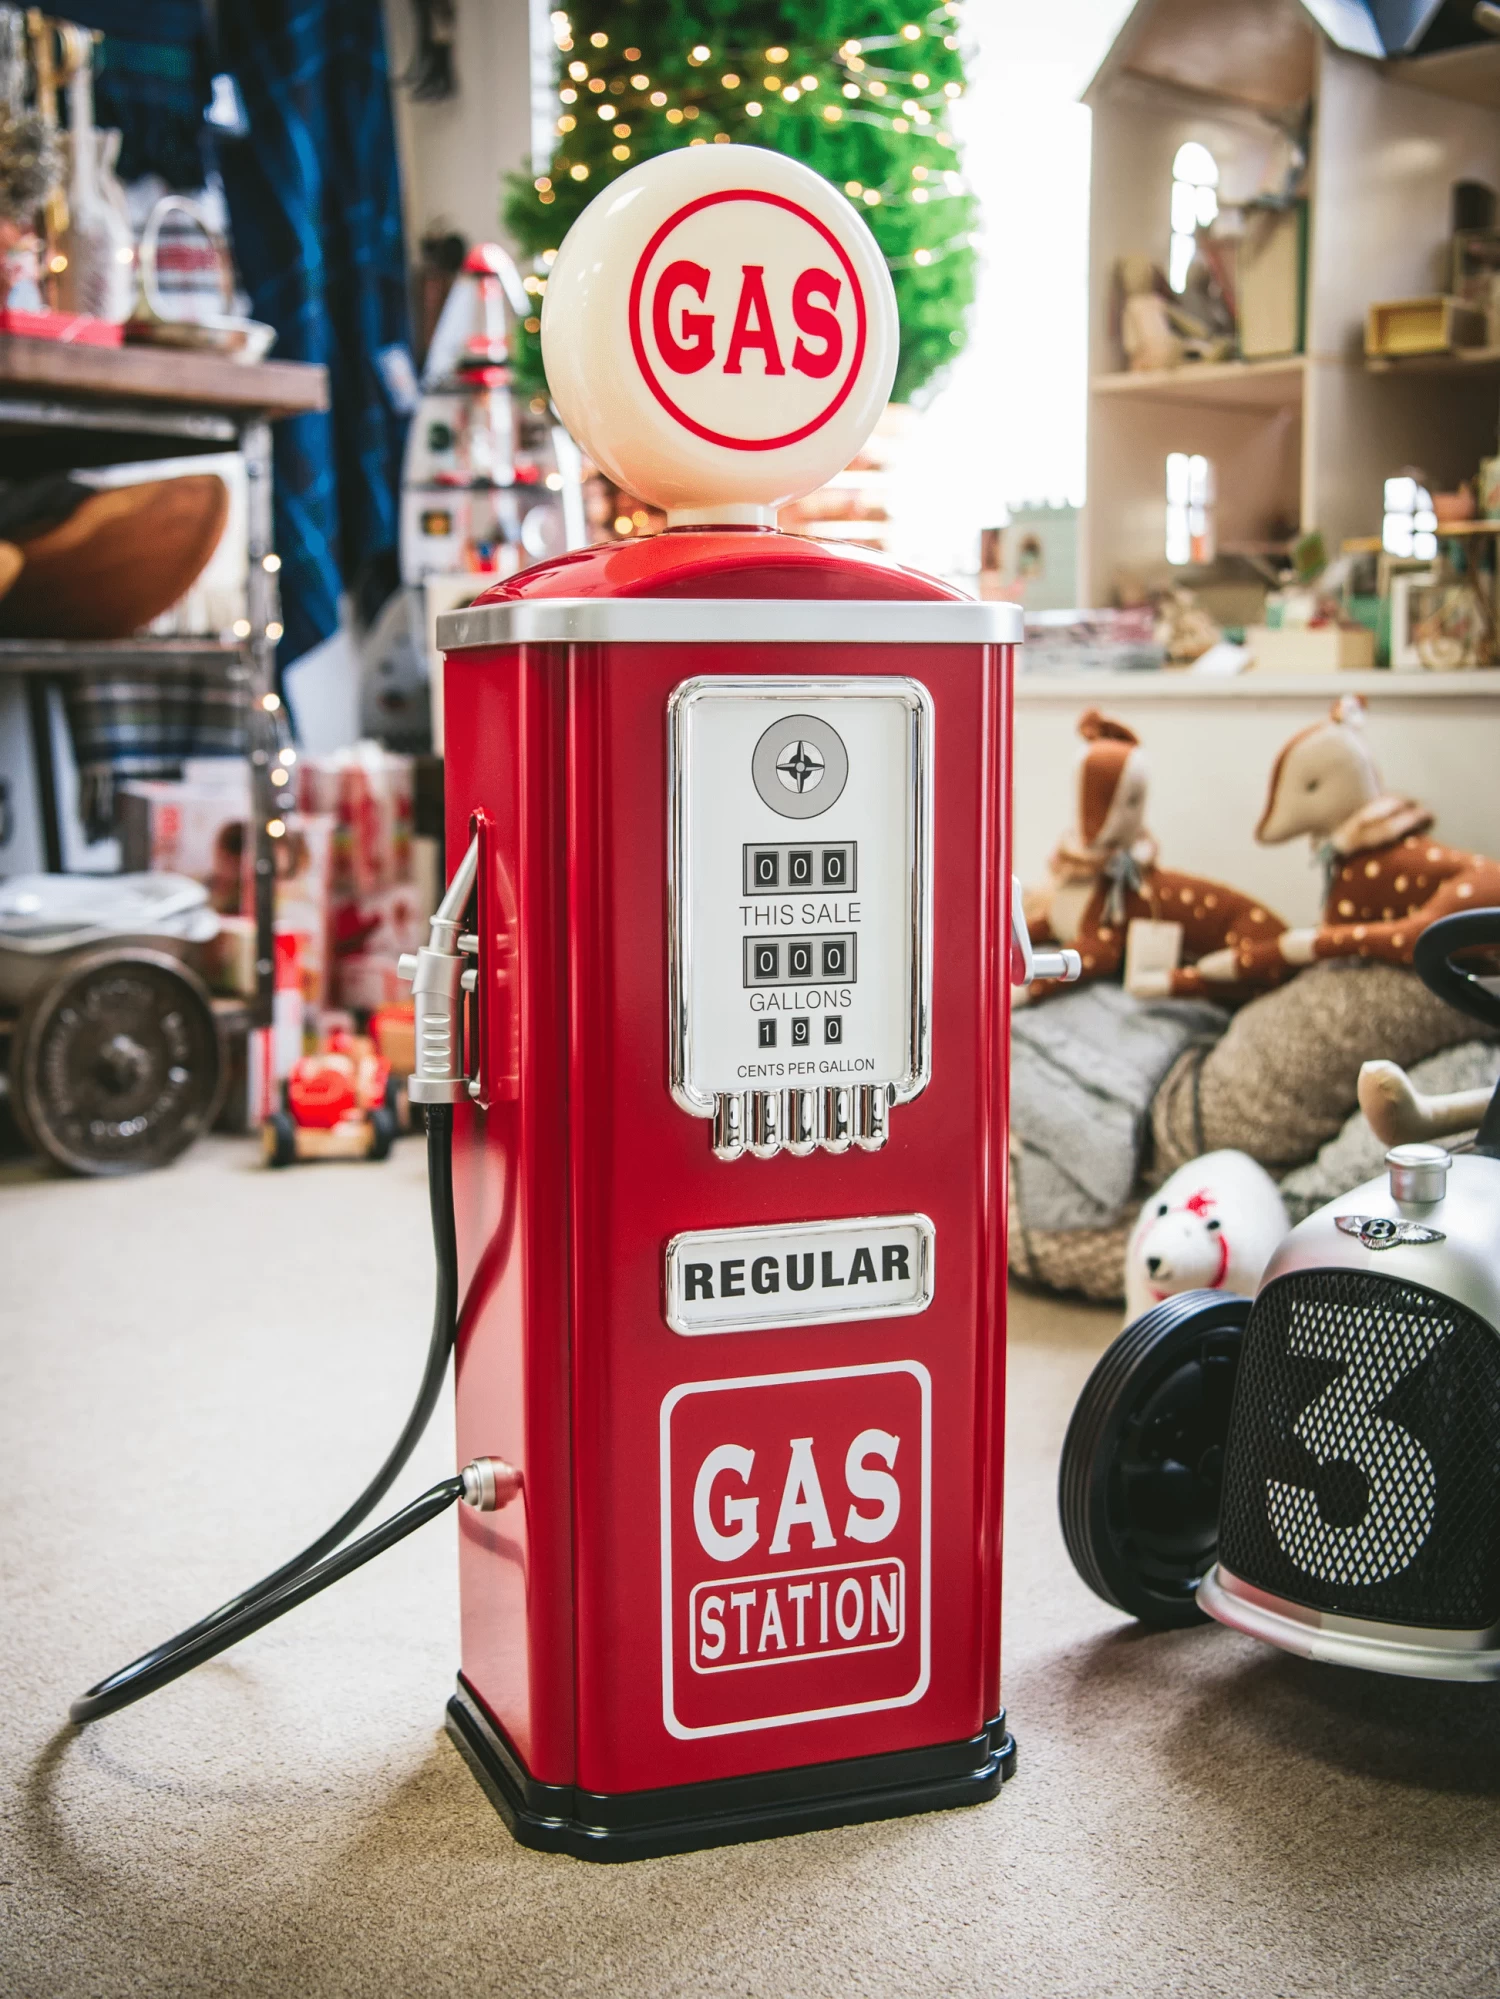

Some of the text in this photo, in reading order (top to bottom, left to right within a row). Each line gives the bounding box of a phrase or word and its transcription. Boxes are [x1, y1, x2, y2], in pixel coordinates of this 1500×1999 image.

[652, 259, 843, 379] GAS
[738, 902, 861, 926] THIS SALE
[749, 988, 852, 1012] GALLONS
[737, 1057, 875, 1078] CENTS PER GALLON
[684, 1243, 911, 1301] REGULAR
[1265, 1299, 1456, 1586] 3
[692, 1428, 901, 1562] GAS
[700, 1571, 899, 1660] STATION
